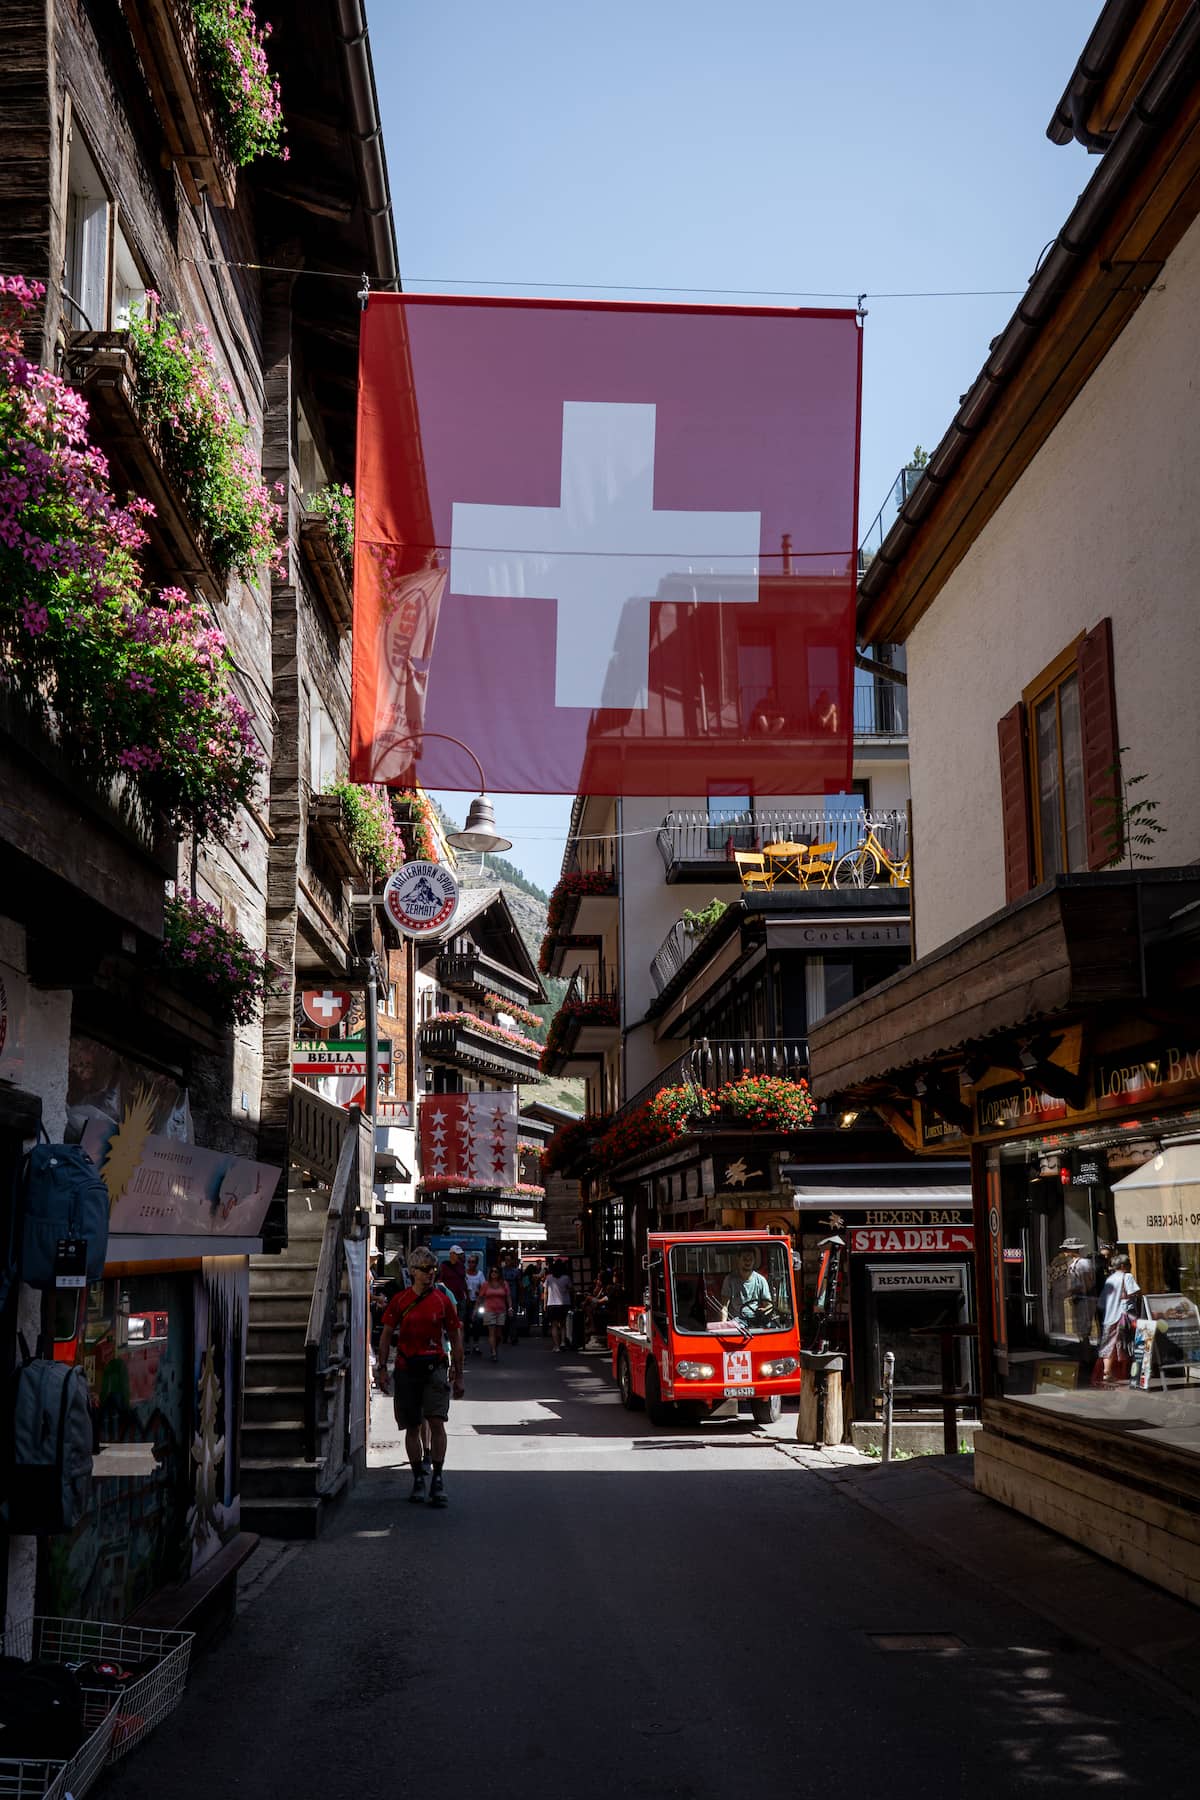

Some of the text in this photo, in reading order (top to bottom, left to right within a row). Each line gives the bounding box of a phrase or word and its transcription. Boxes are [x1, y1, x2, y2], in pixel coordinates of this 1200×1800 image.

[391, 864, 456, 896] MATTERHORN SPORT
[405, 903, 437, 917] ZERMATT
[803, 927, 900, 942] Cocktail
[292, 1041, 328, 1051] ERIA
[308, 1053, 355, 1063] BELLA
[334, 1065, 385, 1075] ITALA
[1098, 1059, 1162, 1099] LORENZ
[980, 1096, 1020, 1126] LORENZ
[865, 1210, 963, 1224] HEXEN BAR
[855, 1230, 950, 1250] STADEL
[878, 1275, 955, 1285] RESTAURANT
